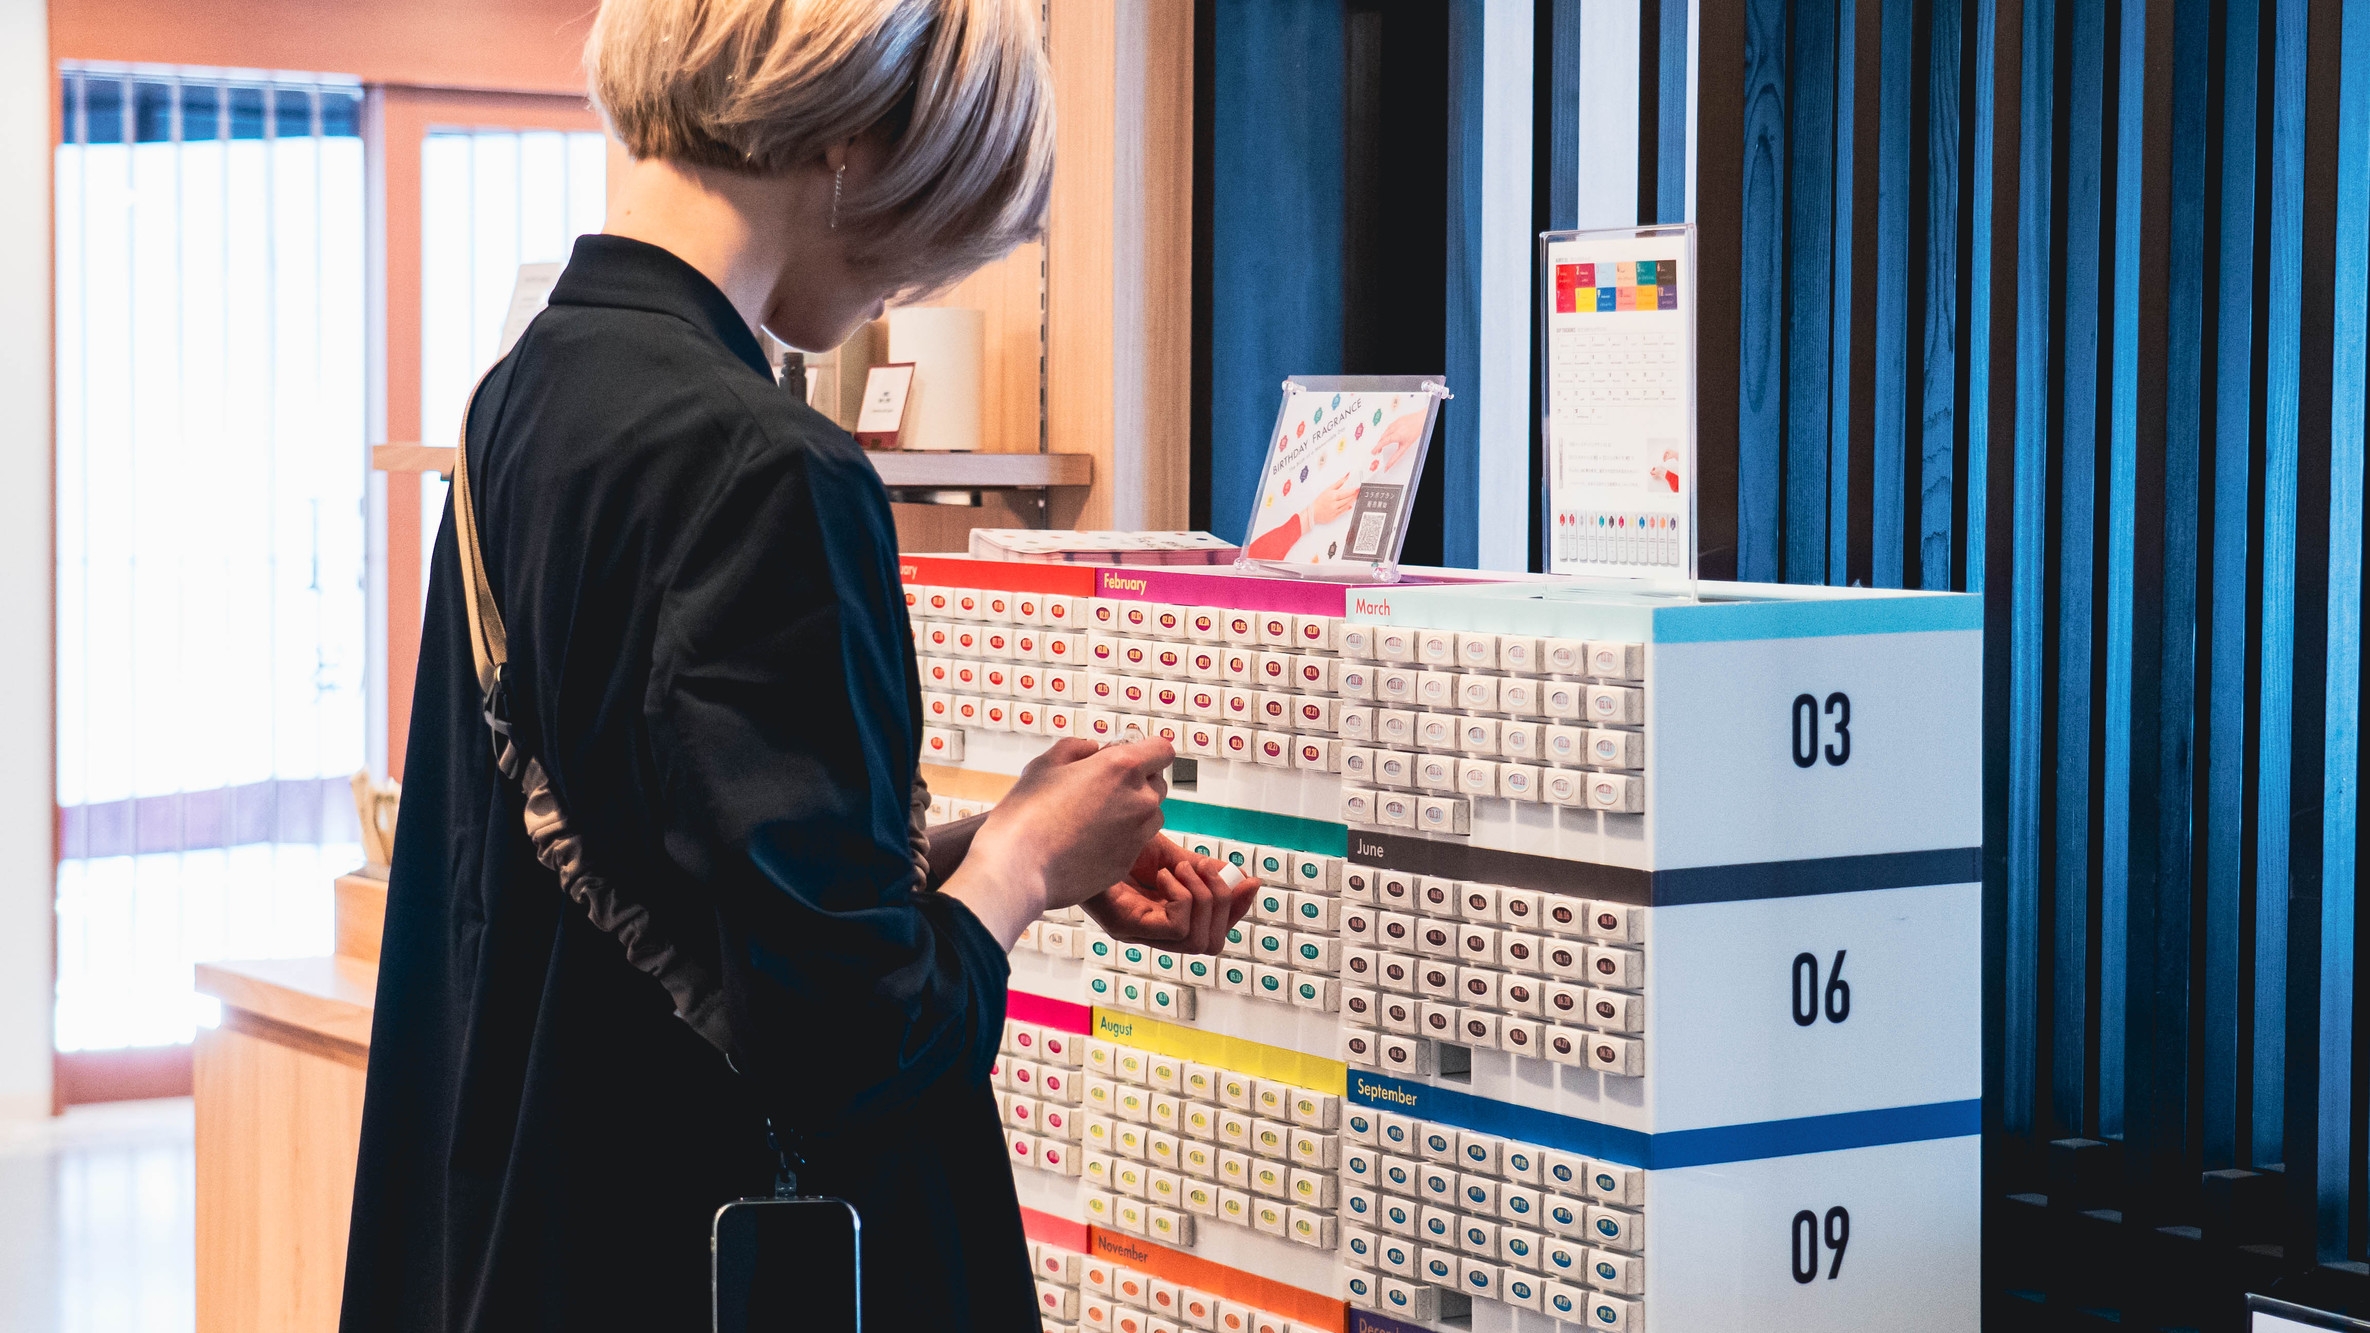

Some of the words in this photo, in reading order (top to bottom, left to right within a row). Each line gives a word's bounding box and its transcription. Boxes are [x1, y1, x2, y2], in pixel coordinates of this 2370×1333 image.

[1272, 440, 1308, 475] BIRTHDAY
[1312, 399, 1362, 443] FRAGRANCE
[1104, 573, 1146, 596] February
[1356, 598, 1390, 616] March
[1792, 692, 1850, 768] 03
[1357, 838, 1384, 857] June
[1792, 950, 1850, 1026] 06
[1101, 1016, 1132, 1037] August
[1358, 1078, 1417, 1106] September
[1098, 1236, 1148, 1263] November
[1792, 1206, 1849, 1284] 09
